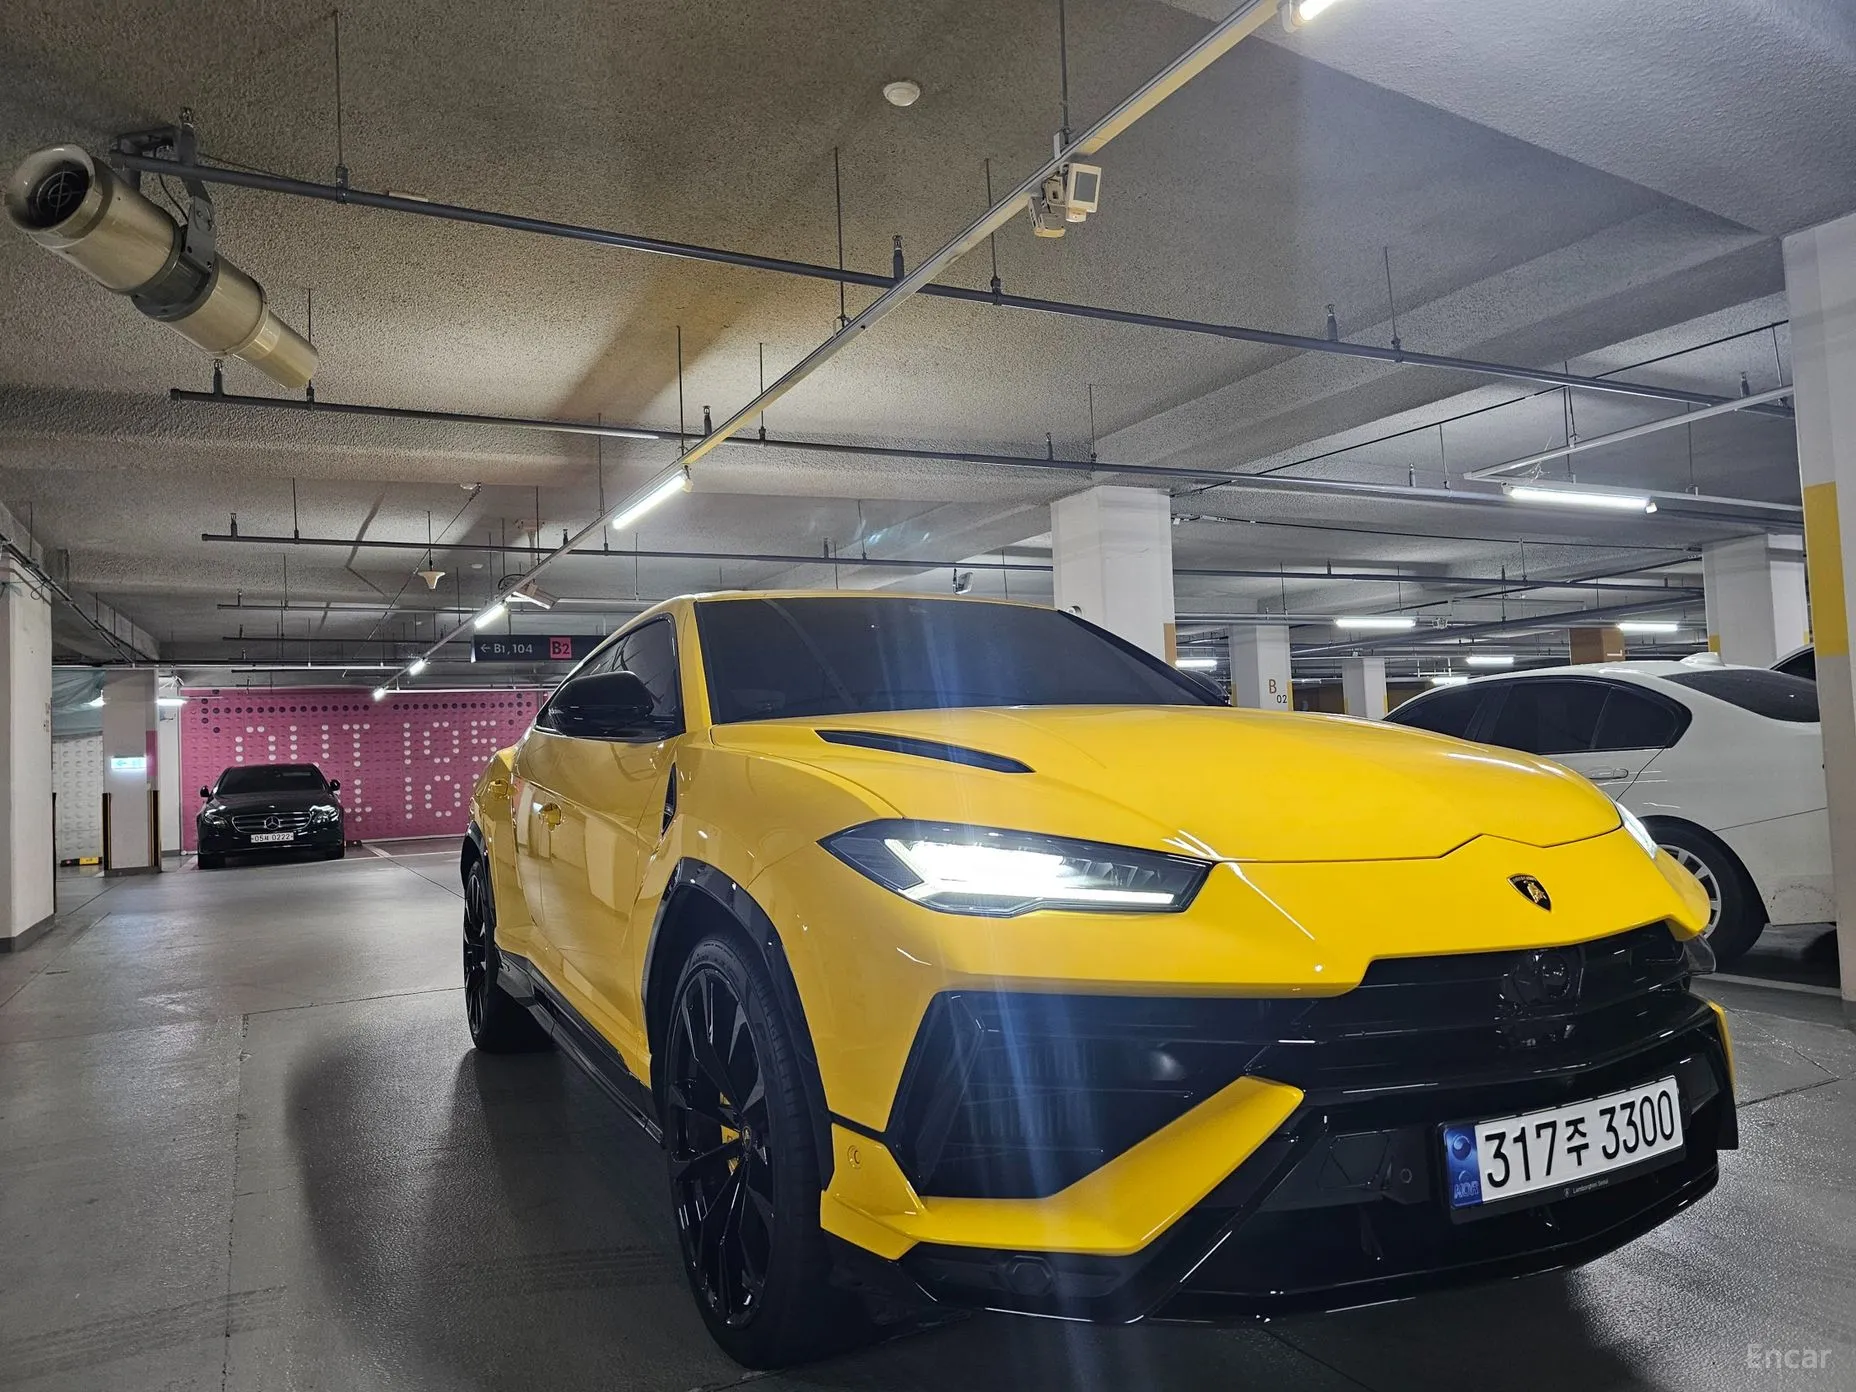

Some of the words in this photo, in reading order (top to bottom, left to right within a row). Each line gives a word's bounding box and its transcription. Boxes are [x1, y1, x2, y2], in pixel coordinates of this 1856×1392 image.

[552, 640, 570, 655] B2
[1268, 678, 1277, 694] B
[1276, 694, 1288, 704] 02
[403, 721, 497, 765] 105
[405, 773, 480, 820] 10
[1484, 1117, 1590, 1189] 317주
[1599, 1090, 1676, 1161] 3300
